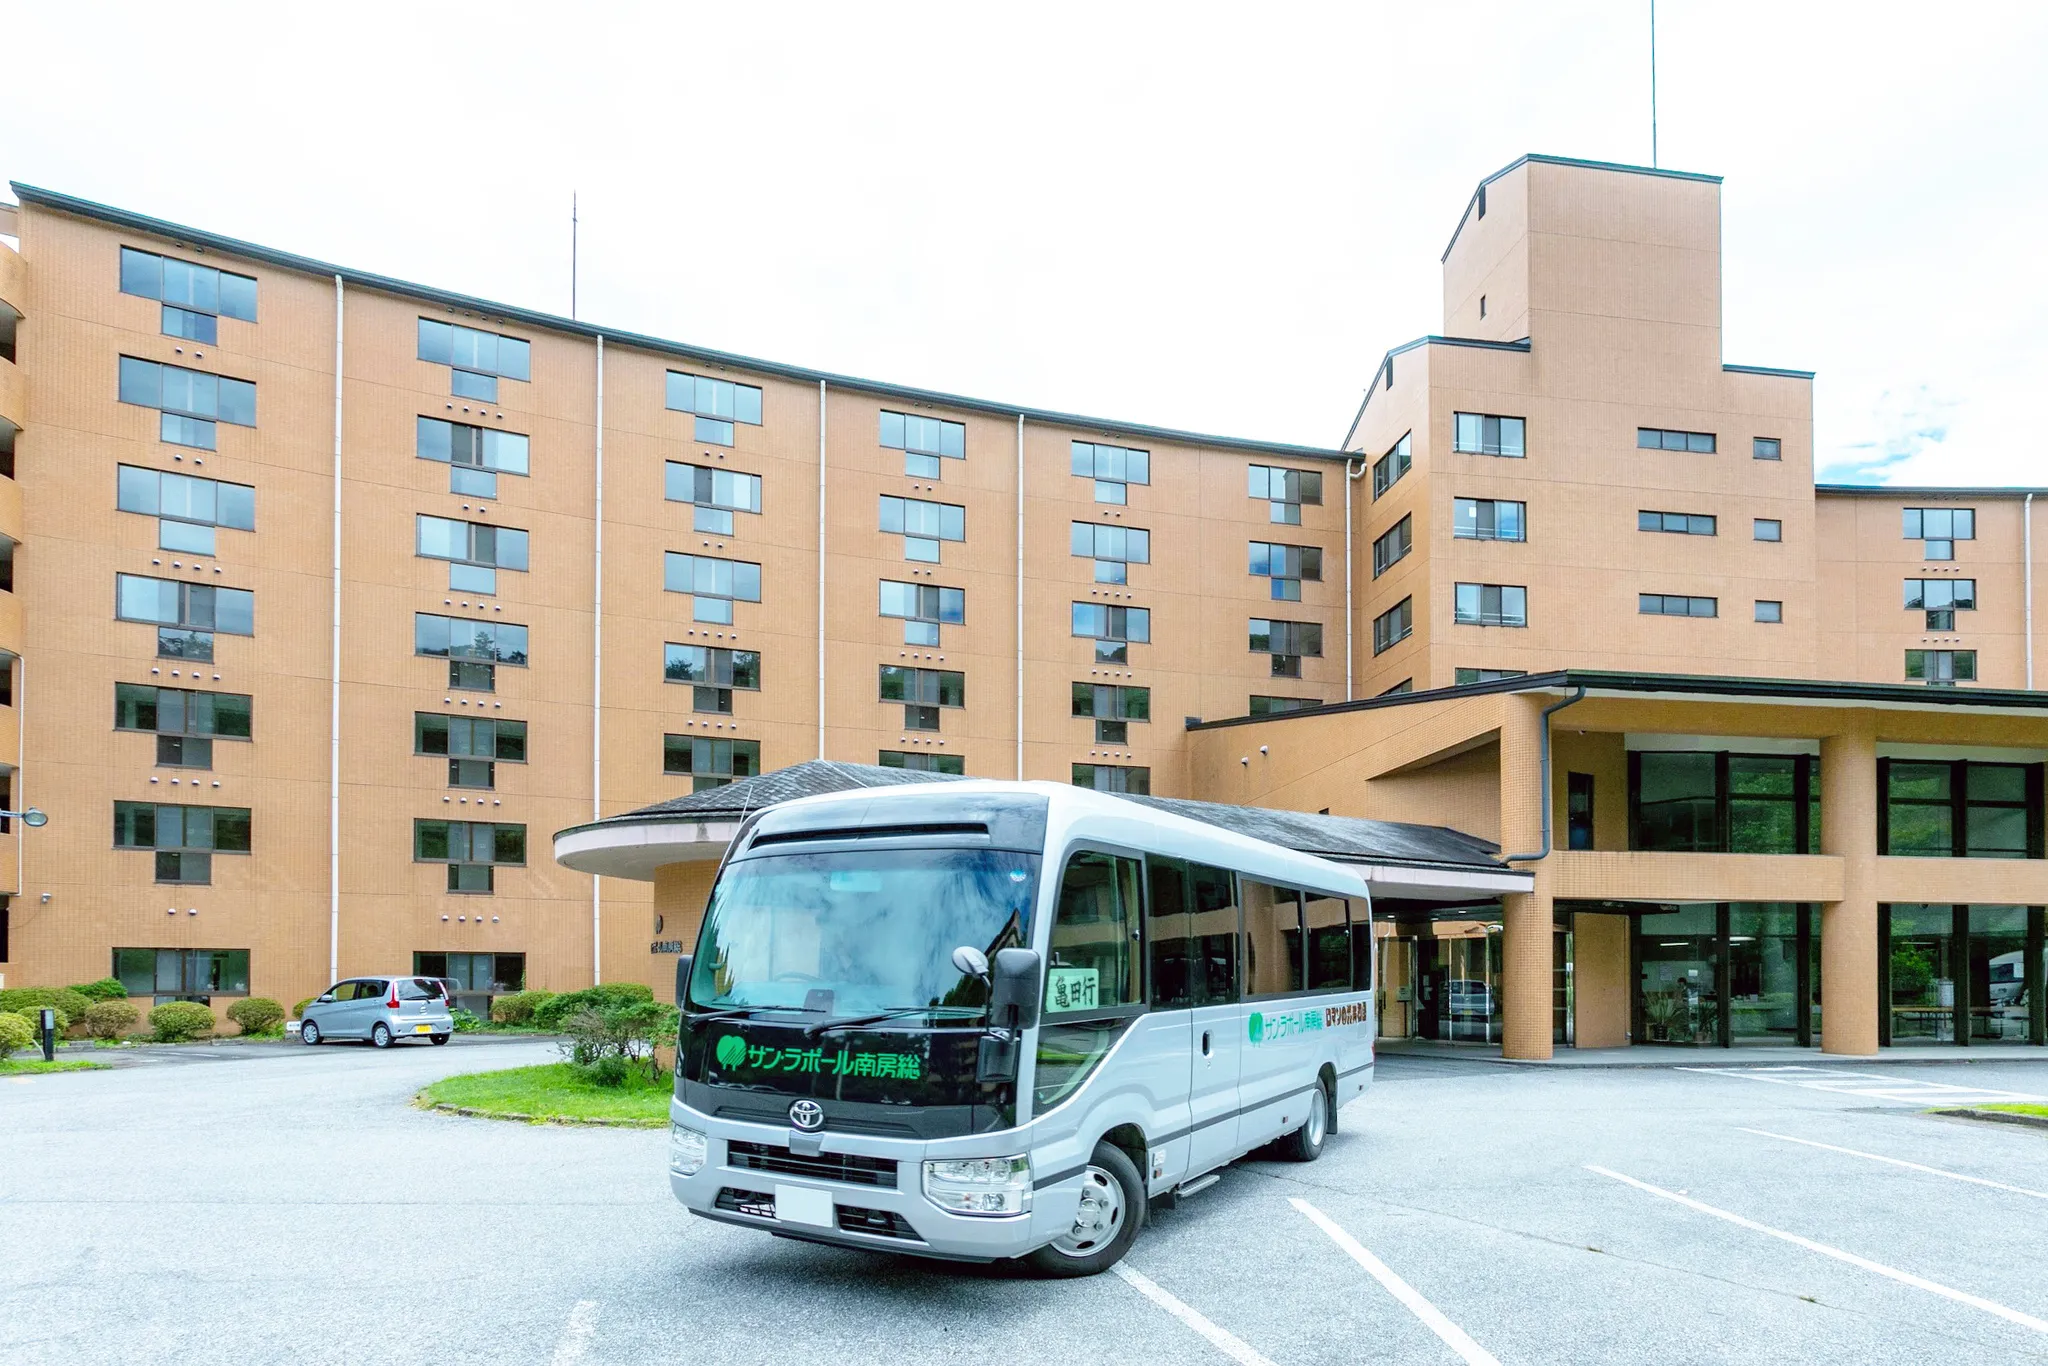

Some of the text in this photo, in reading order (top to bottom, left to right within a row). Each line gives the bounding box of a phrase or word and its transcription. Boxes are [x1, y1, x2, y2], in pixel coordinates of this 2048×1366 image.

[748, 1044, 921, 1080] サン・ラポール南房総
